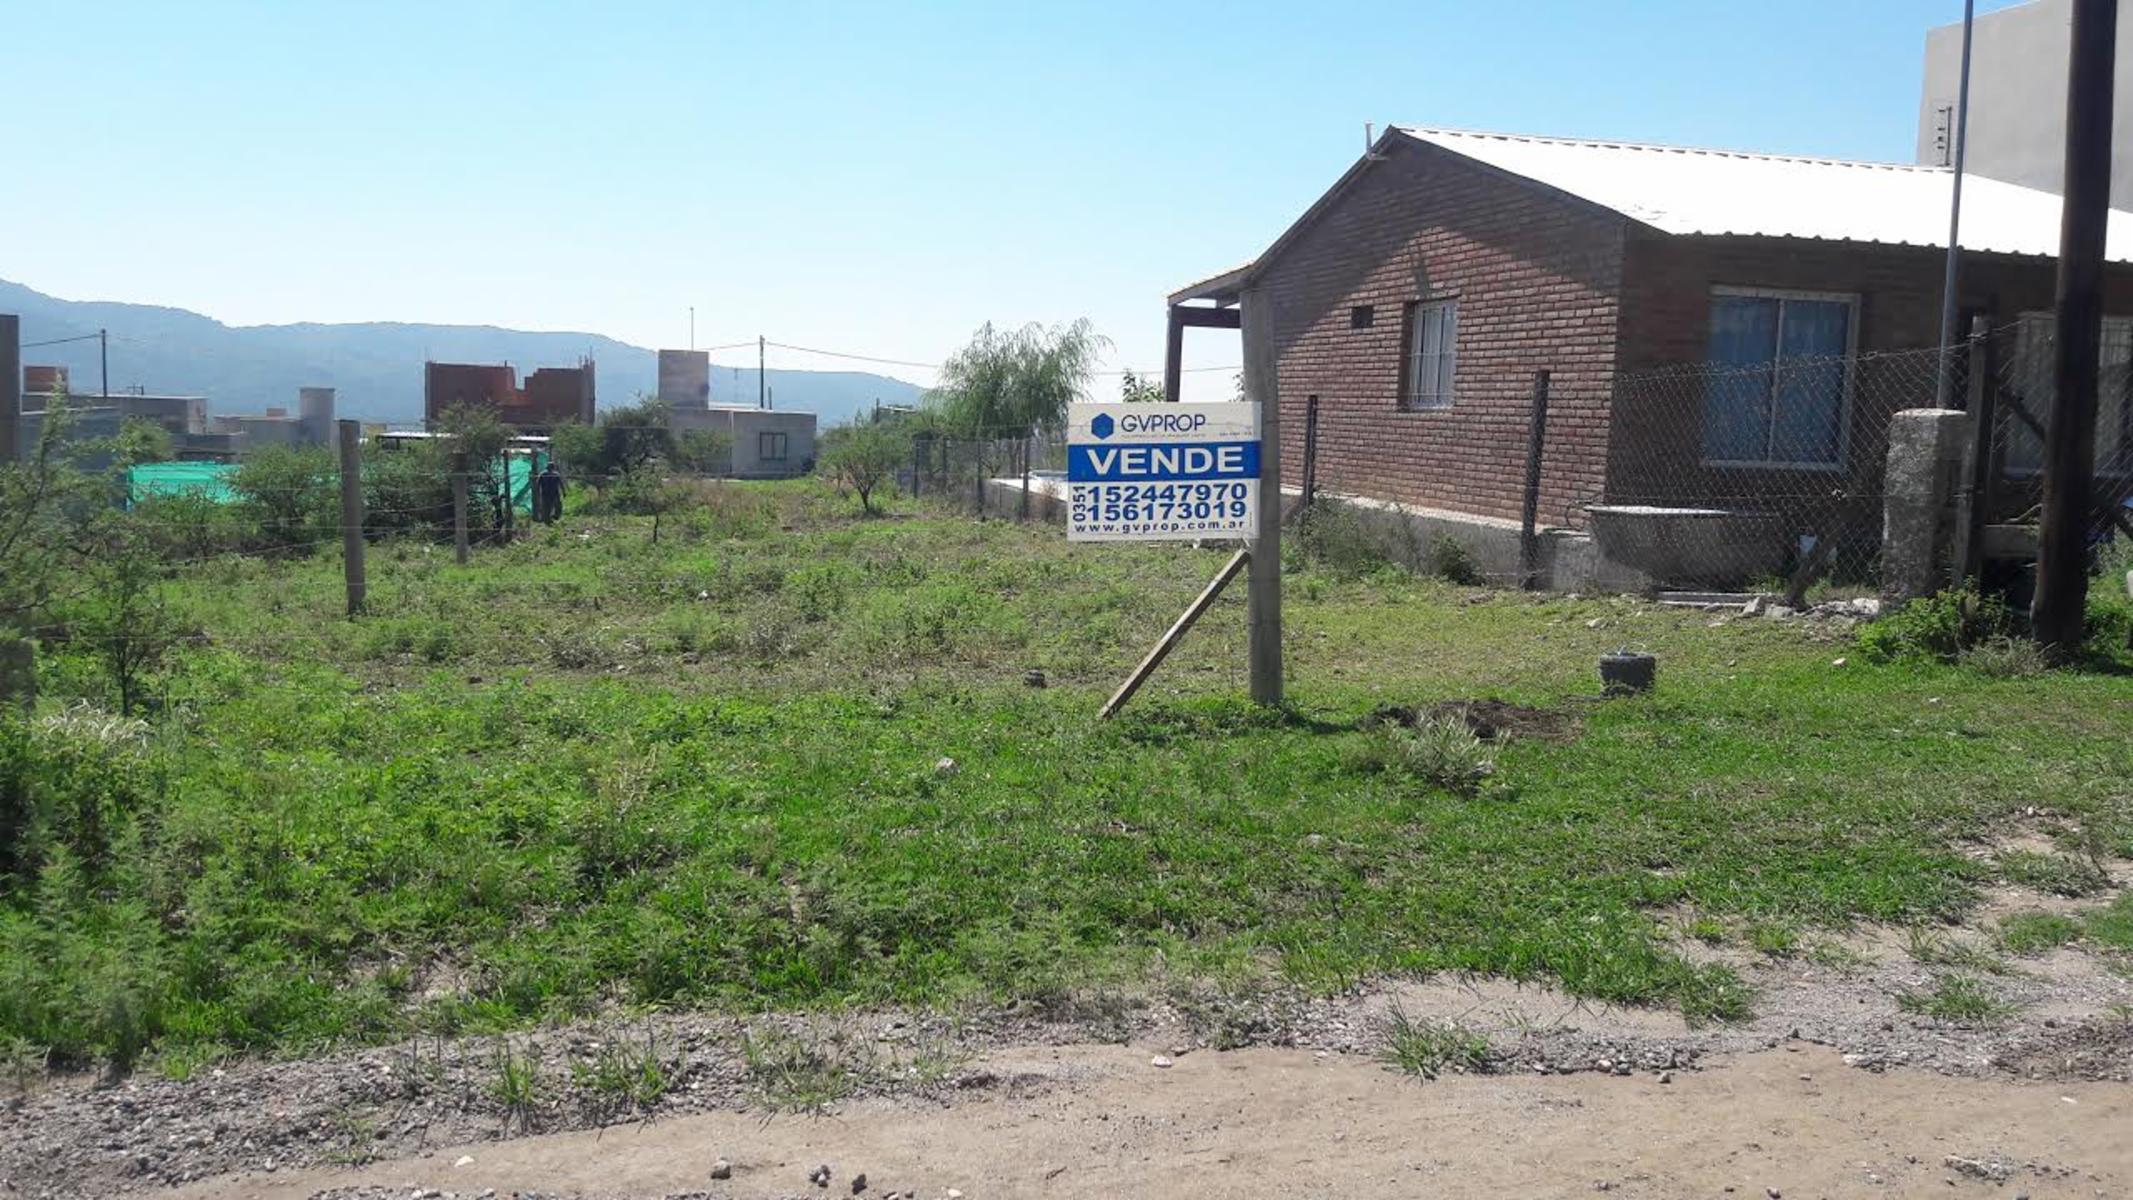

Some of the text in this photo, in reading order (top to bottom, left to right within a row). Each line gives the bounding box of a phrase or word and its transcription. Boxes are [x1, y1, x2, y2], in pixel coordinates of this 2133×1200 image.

[1121, 414, 1206, 433] GVPROP
[1087, 446, 1244, 475] VENDE
[1087, 483, 1248, 503] 152447970
[1073, 486, 1086, 522] 0351
[1087, 501, 1247, 521] 156173019
[1075, 521, 1245, 534] www.gvprop.com.ar
